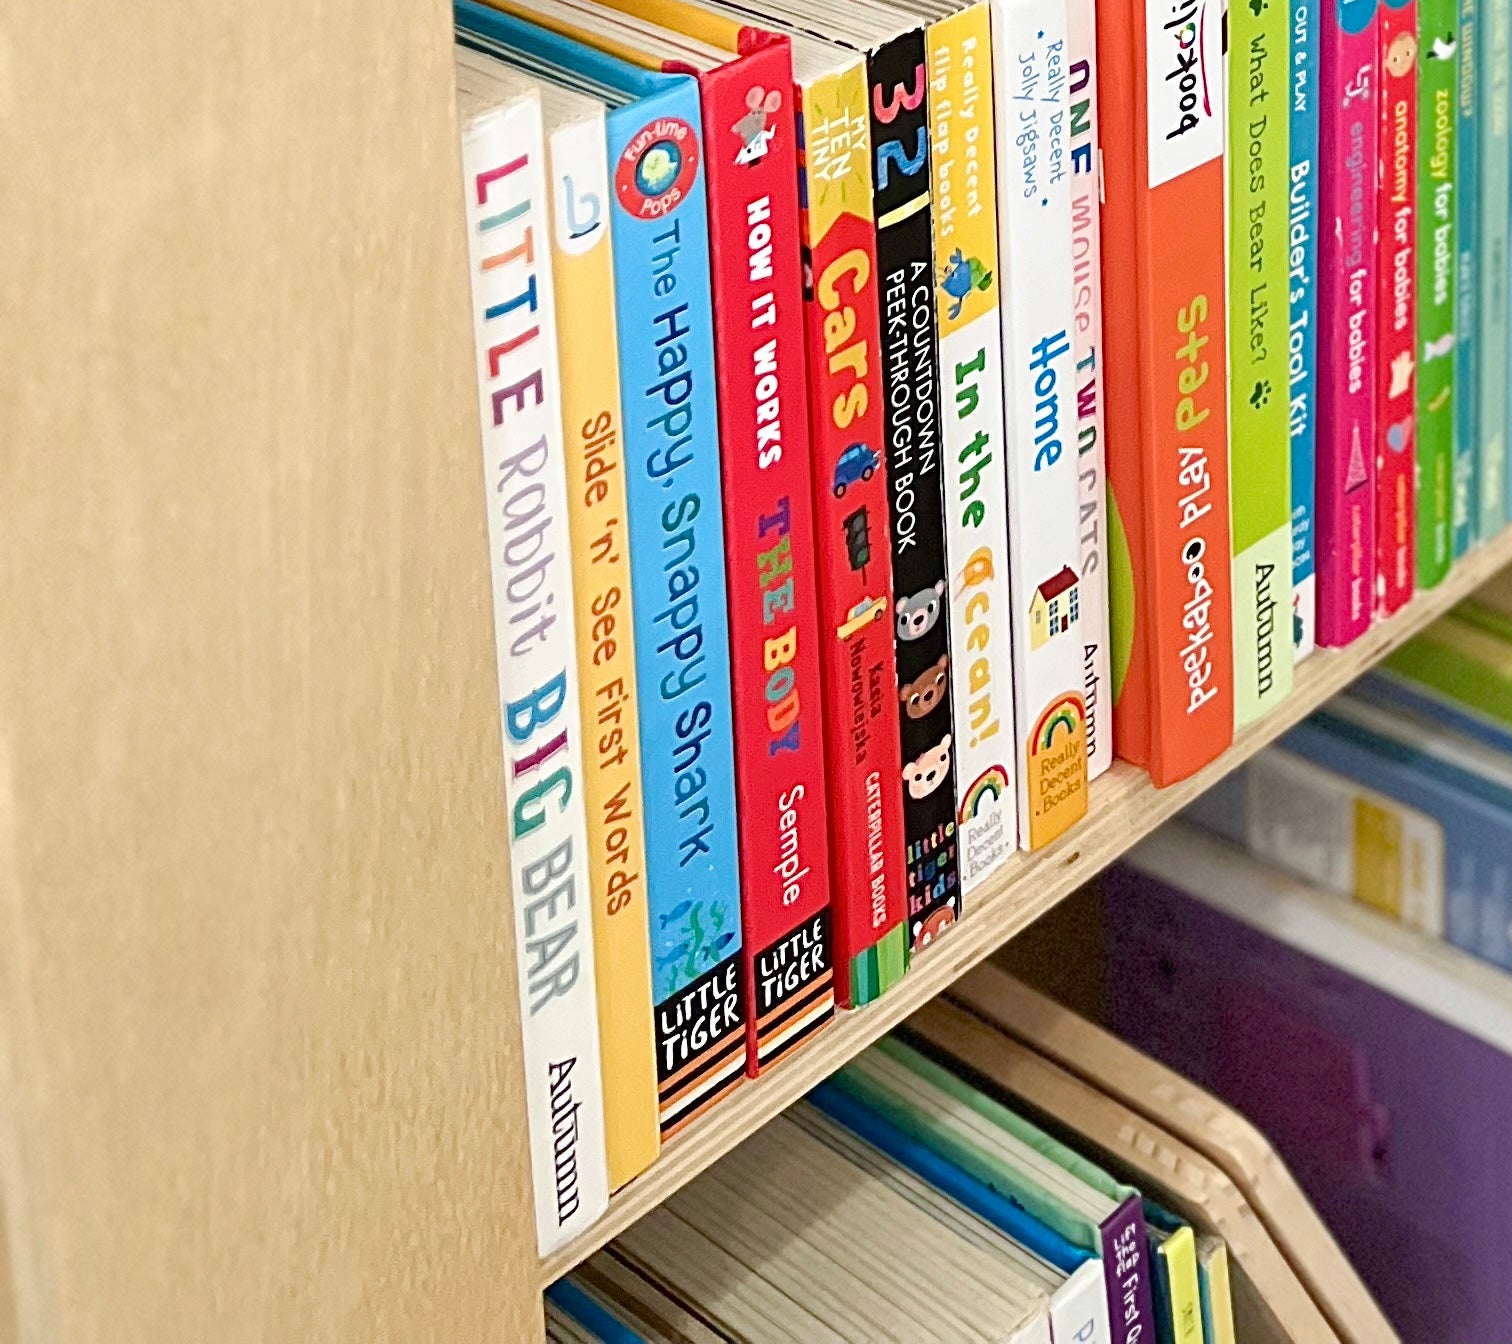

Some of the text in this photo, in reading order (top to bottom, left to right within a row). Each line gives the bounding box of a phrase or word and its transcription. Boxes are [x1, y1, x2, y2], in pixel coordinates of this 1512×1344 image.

[873, 64, 930, 230] 3 2 1
[961, 35, 984, 218] Really Decent
[1012, 51, 1042, 200] Jolly Jigsaws
[1045, 38, 1066, 186] Really Decent
[1249, 32, 1269, 365] What Does Bear Like?
[1346, 122, 1367, 394] engineering for babies
[1391, 101, 1411, 331] anatomy for babies
[1430, 89, 1453, 306] zoology for babies
[818, 247, 872, 430] Cars
[885, 269, 917, 556] PEEK-THROUGH BOOK
[910, 261, 937, 476] A COUNTDOWN
[1031, 329, 1068, 473] Home
[581, 409, 616, 508] Slide
[746, 194, 801, 758] HOW IT WORKS THE BODY
[477, 153, 580, 1018] LITTLE Rabbit BIG BEAR
[645, 218, 716, 867] The Happy, Snappy Shark
[955, 345, 1000, 749] In the Ocean!
[591, 585, 622, 667] See
[849, 637, 868, 766] Nowowiejska
[868, 659, 884, 719] Kasia
[1180, 537, 1218, 714] peekaboo
[1255, 564, 1278, 699] Autumn
[595, 677, 630, 771] First
[602, 781, 639, 918] Words
[773, 783, 811, 907] Semple
[864, 771, 889, 930] CATERPILLAR BOOKS
[907, 821, 955, 865] little
[909, 843, 955, 888] tiger
[909, 871, 956, 913] kids
[548, 1056, 581, 1227] Autumn
